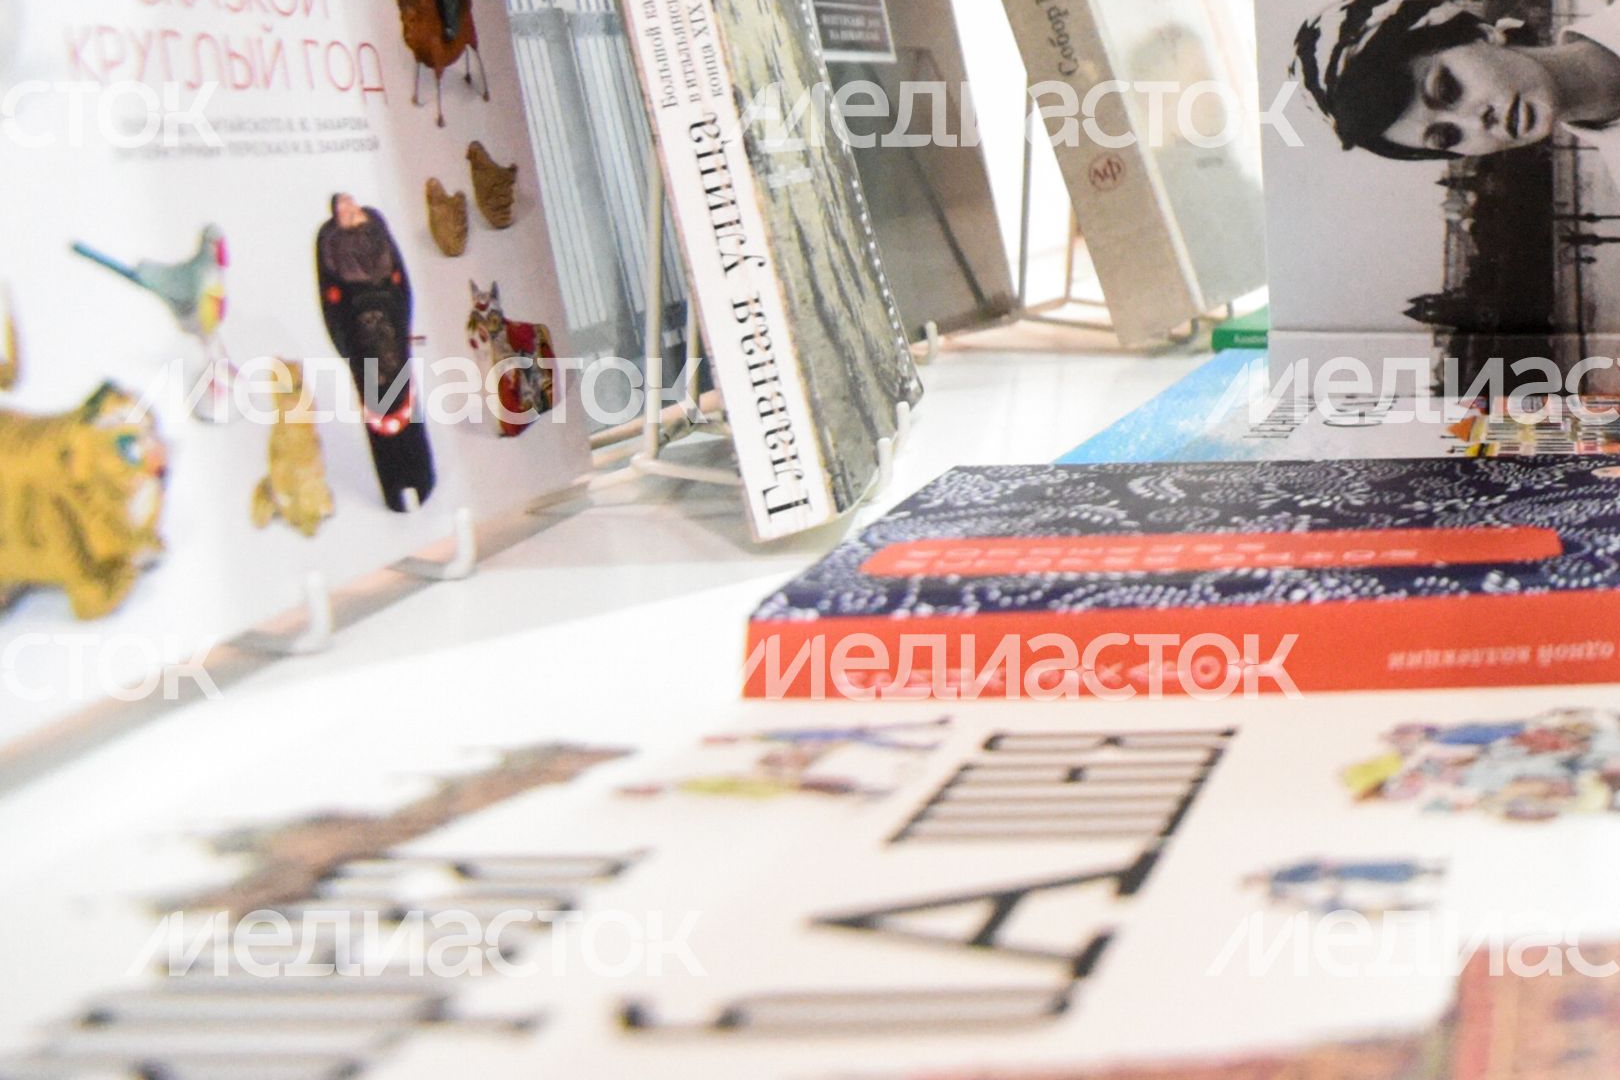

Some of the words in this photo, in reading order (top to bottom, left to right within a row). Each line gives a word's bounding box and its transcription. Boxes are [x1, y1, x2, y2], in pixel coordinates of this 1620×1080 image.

[66, 24, 291, 93] КРУГЛЫЙ
[301, 38, 388, 106] ГОД
[643, 25, 679, 109] Большой
[701, 44, 724, 98] конца
[1044, 3, 1079, 77] Собор
[689, 112, 766, 278] улица
[732, 293, 812, 523] Главная
[1537, 640, 1615, 668] одной
